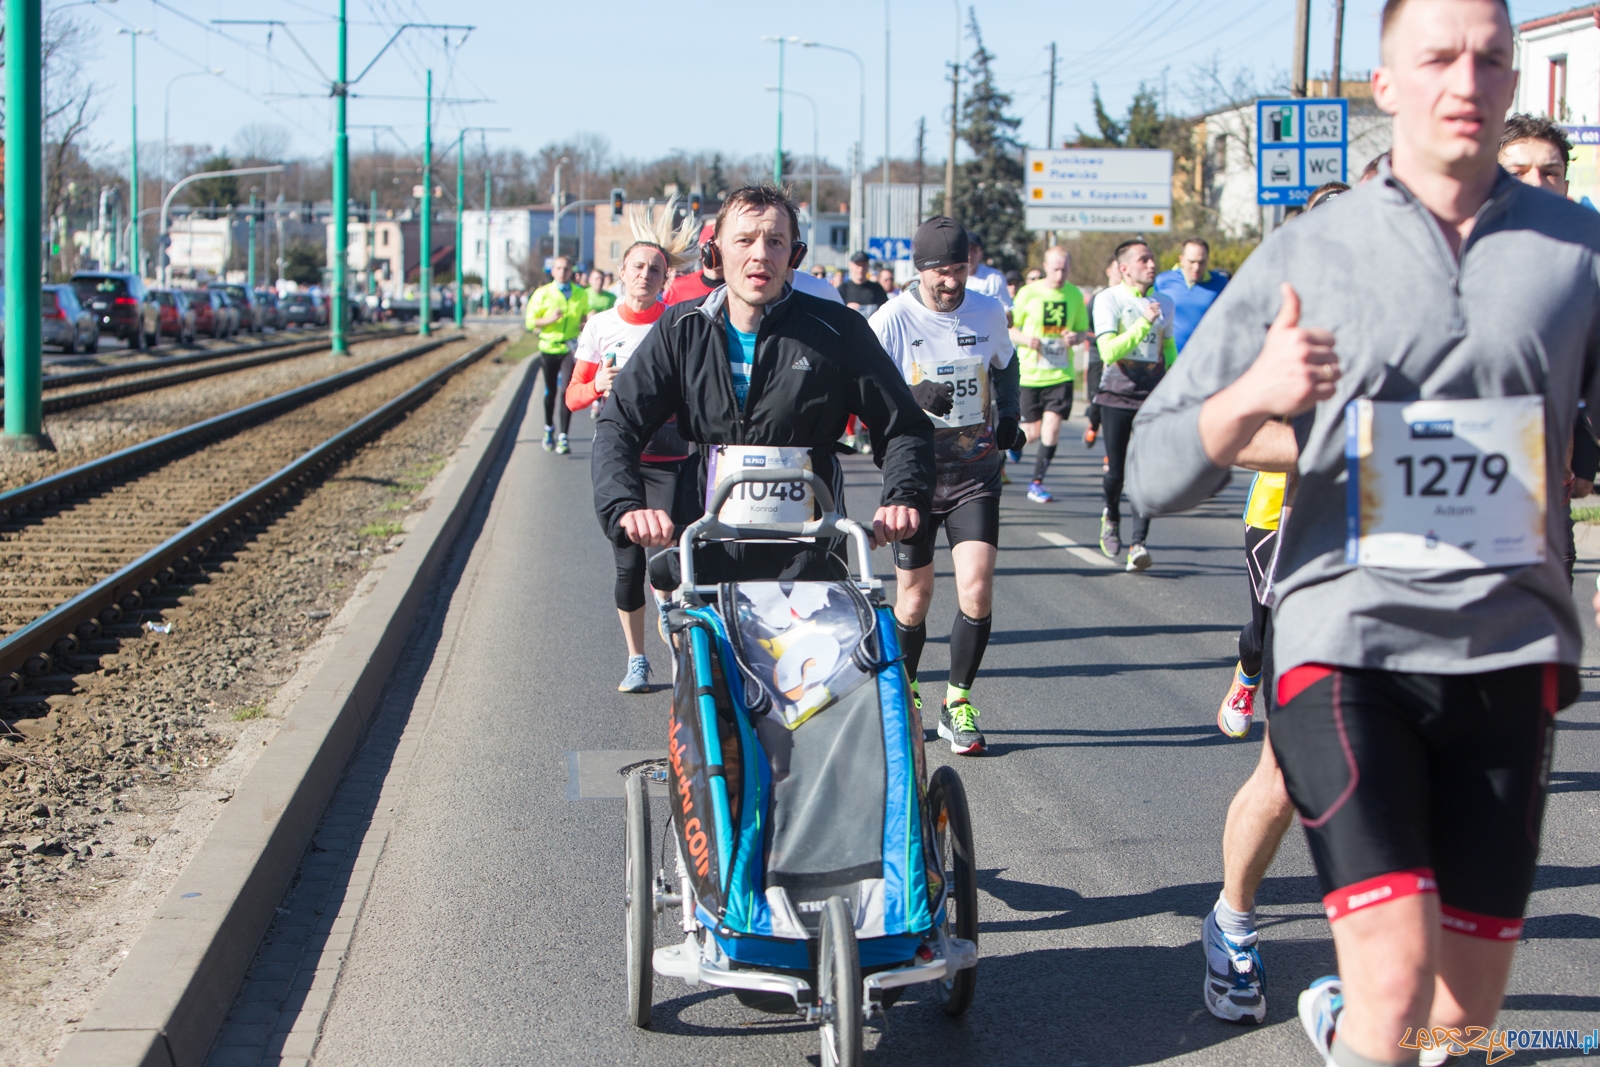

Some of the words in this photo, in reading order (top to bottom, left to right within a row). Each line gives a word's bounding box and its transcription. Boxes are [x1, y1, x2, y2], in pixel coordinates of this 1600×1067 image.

[1307, 110, 1338, 123] LPG
[1307, 125, 1338, 138] GAZ
[1309, 158, 1338, 173] WC
[1395, 453, 1509, 497] 1279
[728, 480, 806, 502] 1048
[750, 504, 779, 513] Konrad
[1434, 504, 1477, 516] Adam
